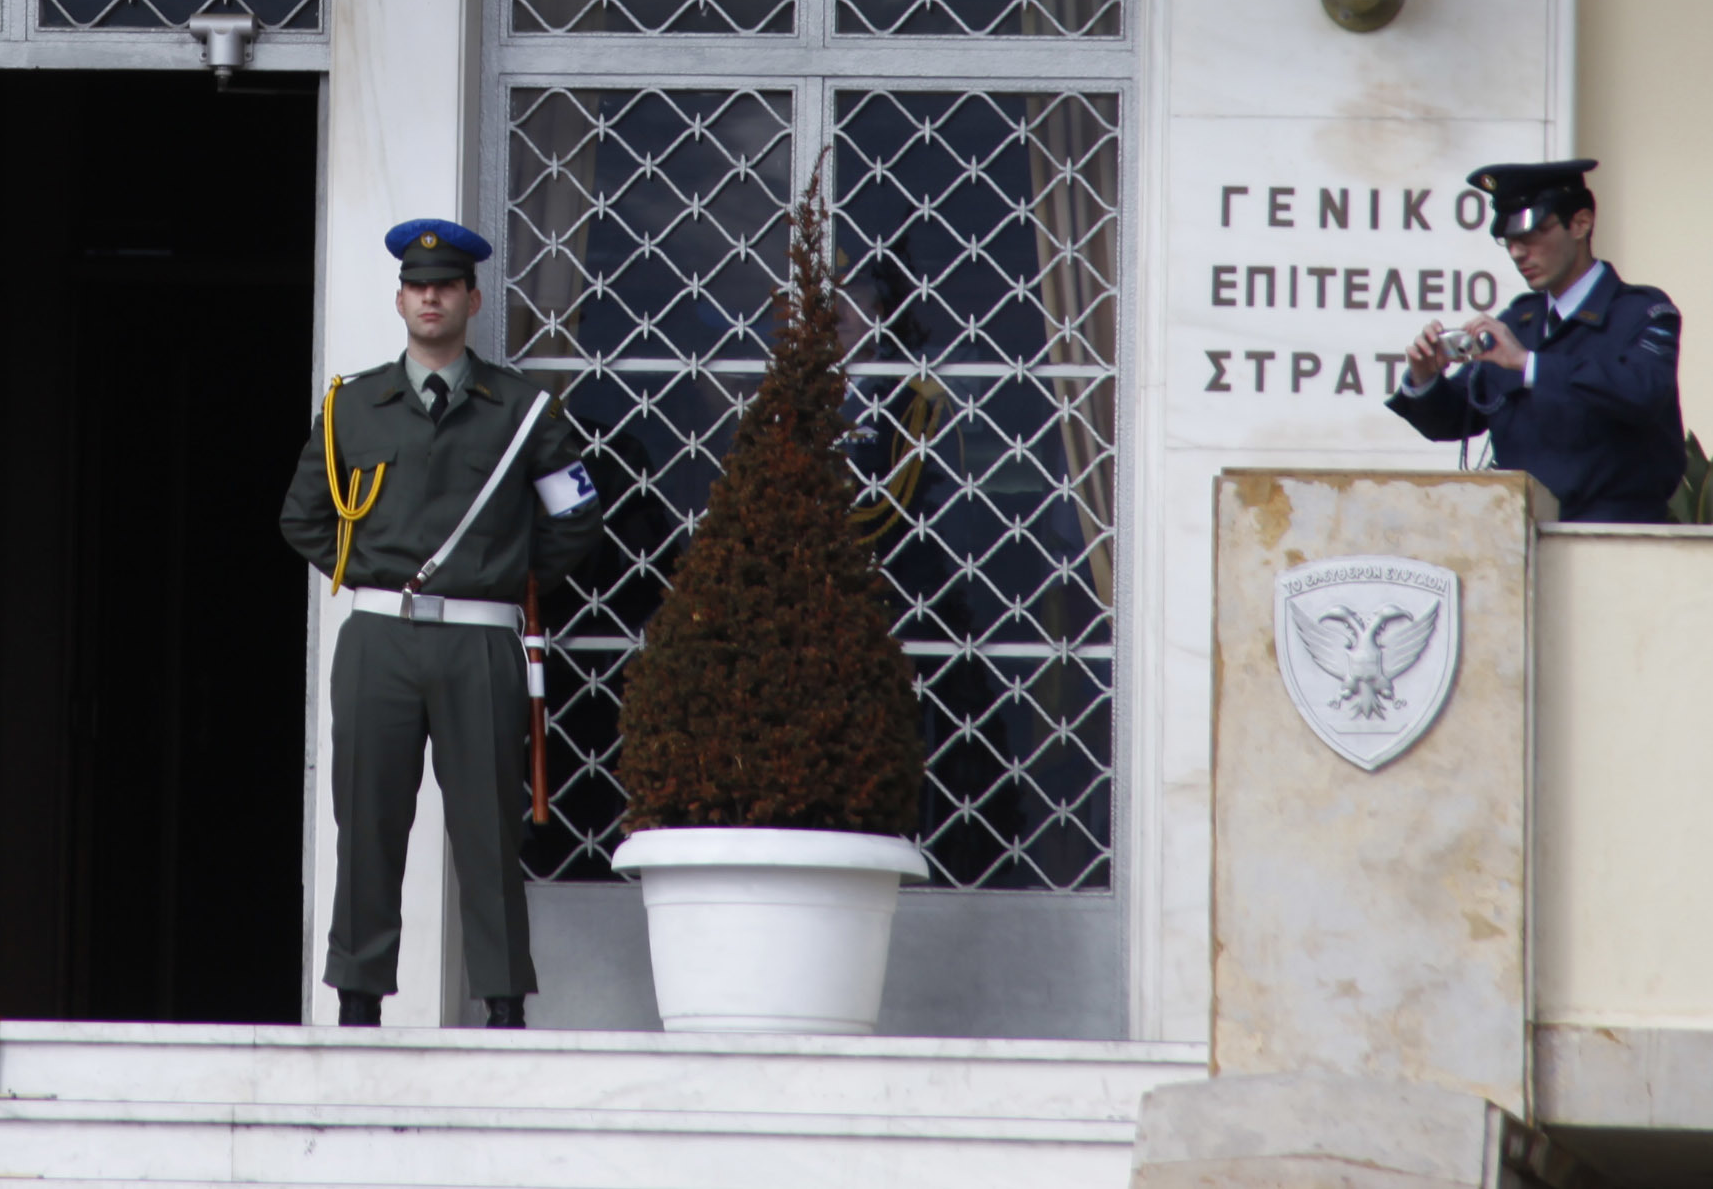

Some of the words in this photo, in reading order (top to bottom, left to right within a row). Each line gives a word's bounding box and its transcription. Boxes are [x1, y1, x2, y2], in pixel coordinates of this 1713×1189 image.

[1221, 186, 1486, 231] ΓΕΝΙΚΟ
[1211, 265, 1497, 312] ΕΠΙΤΕΛΕΙΟ
[1204, 351, 1407, 395] ΣΤΡΑΤ
